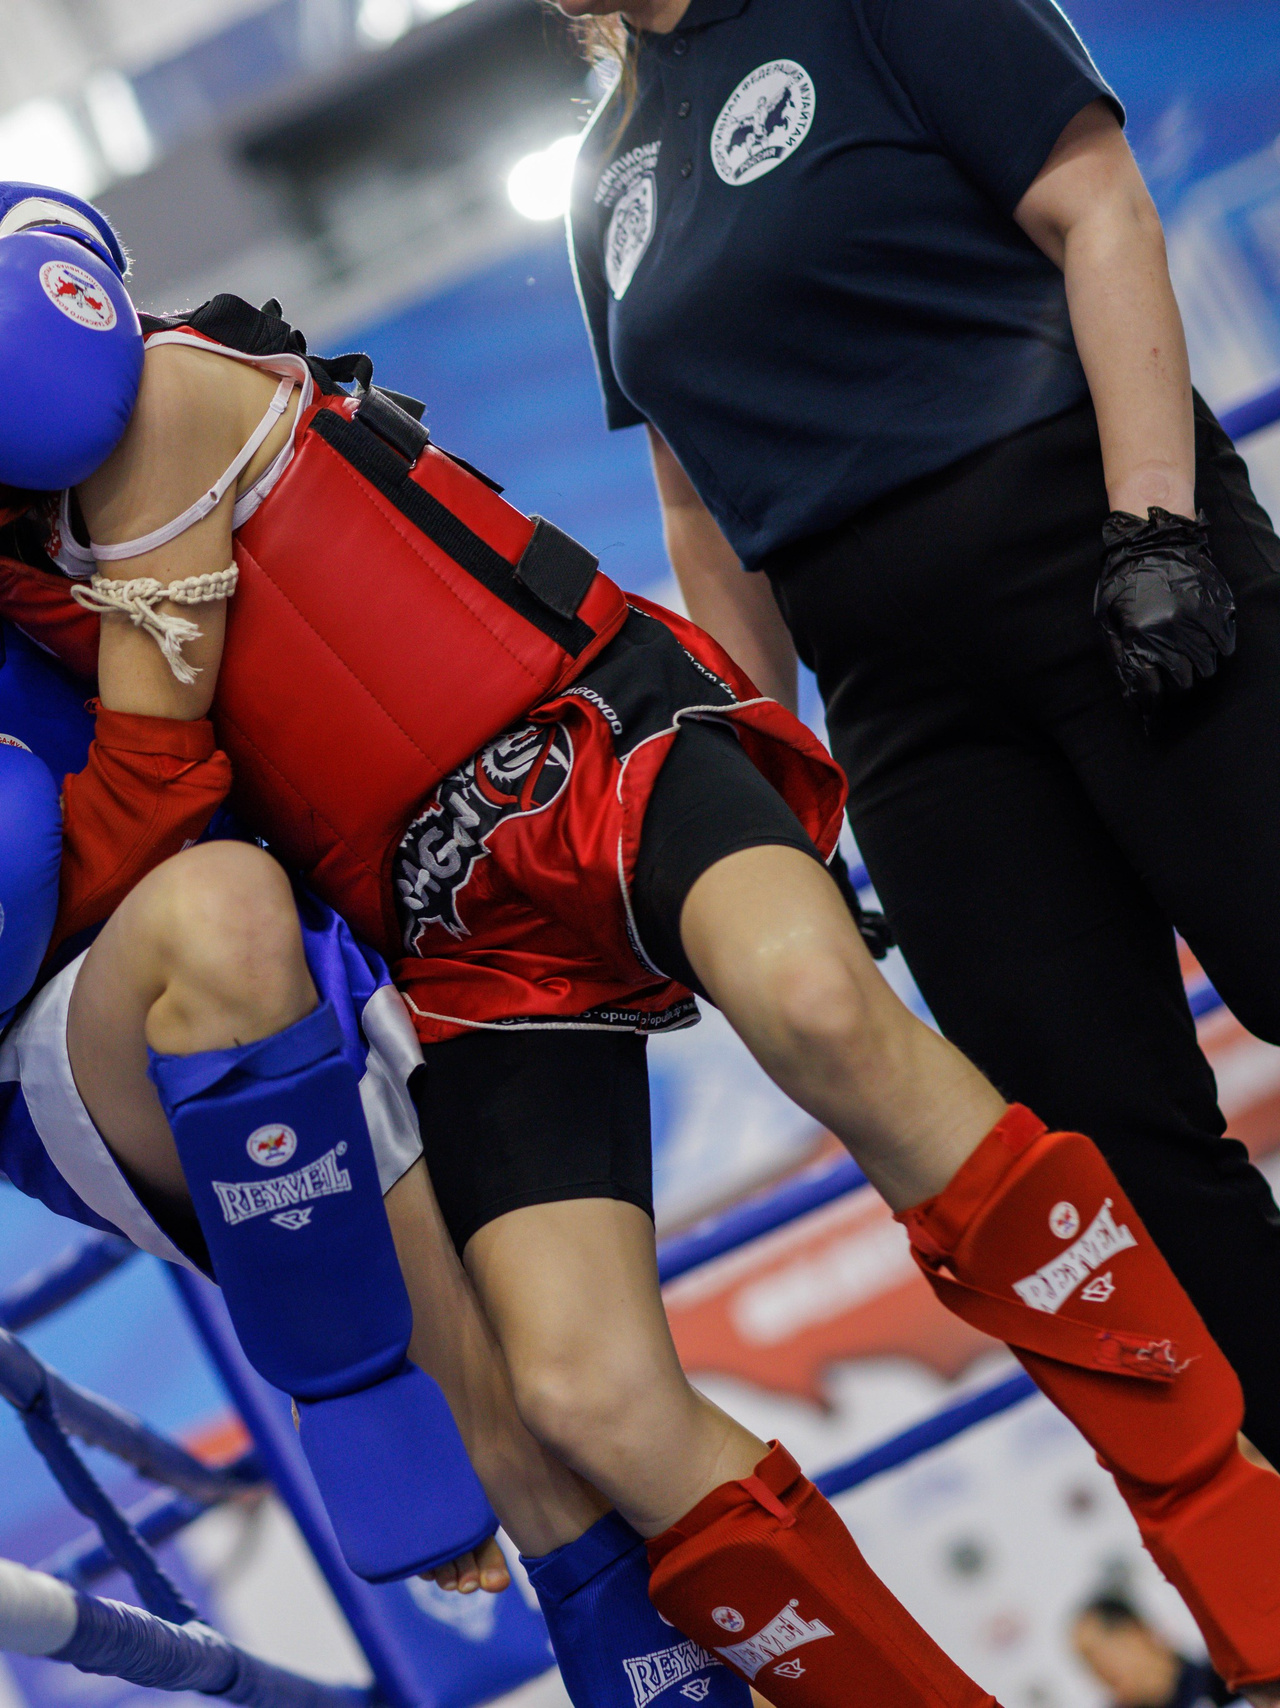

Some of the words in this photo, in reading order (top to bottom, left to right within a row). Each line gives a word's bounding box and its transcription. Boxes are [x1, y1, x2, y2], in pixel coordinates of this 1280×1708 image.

[785, 82, 812, 147] МУАЙТАЙ
[211, 1148, 352, 1225] REYVEL
[1011, 1202, 1138, 1315] REYVEL
